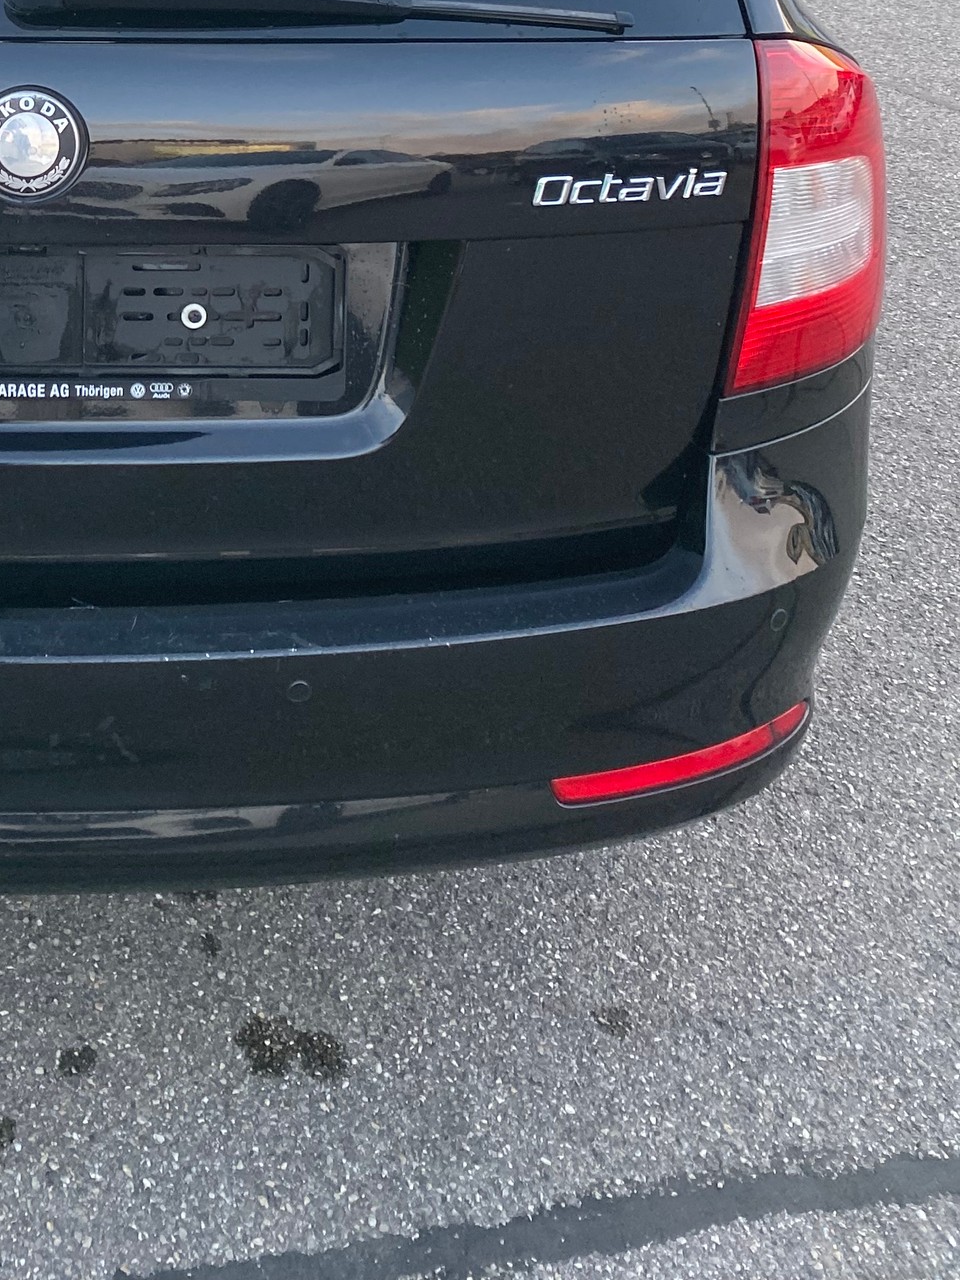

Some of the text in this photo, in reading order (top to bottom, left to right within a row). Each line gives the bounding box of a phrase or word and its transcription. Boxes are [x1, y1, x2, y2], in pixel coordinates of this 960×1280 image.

[533, 168, 728, 207] Octavia
[49, 383, 70, 398] AG
[74, 384, 124, 399] Thörigen
